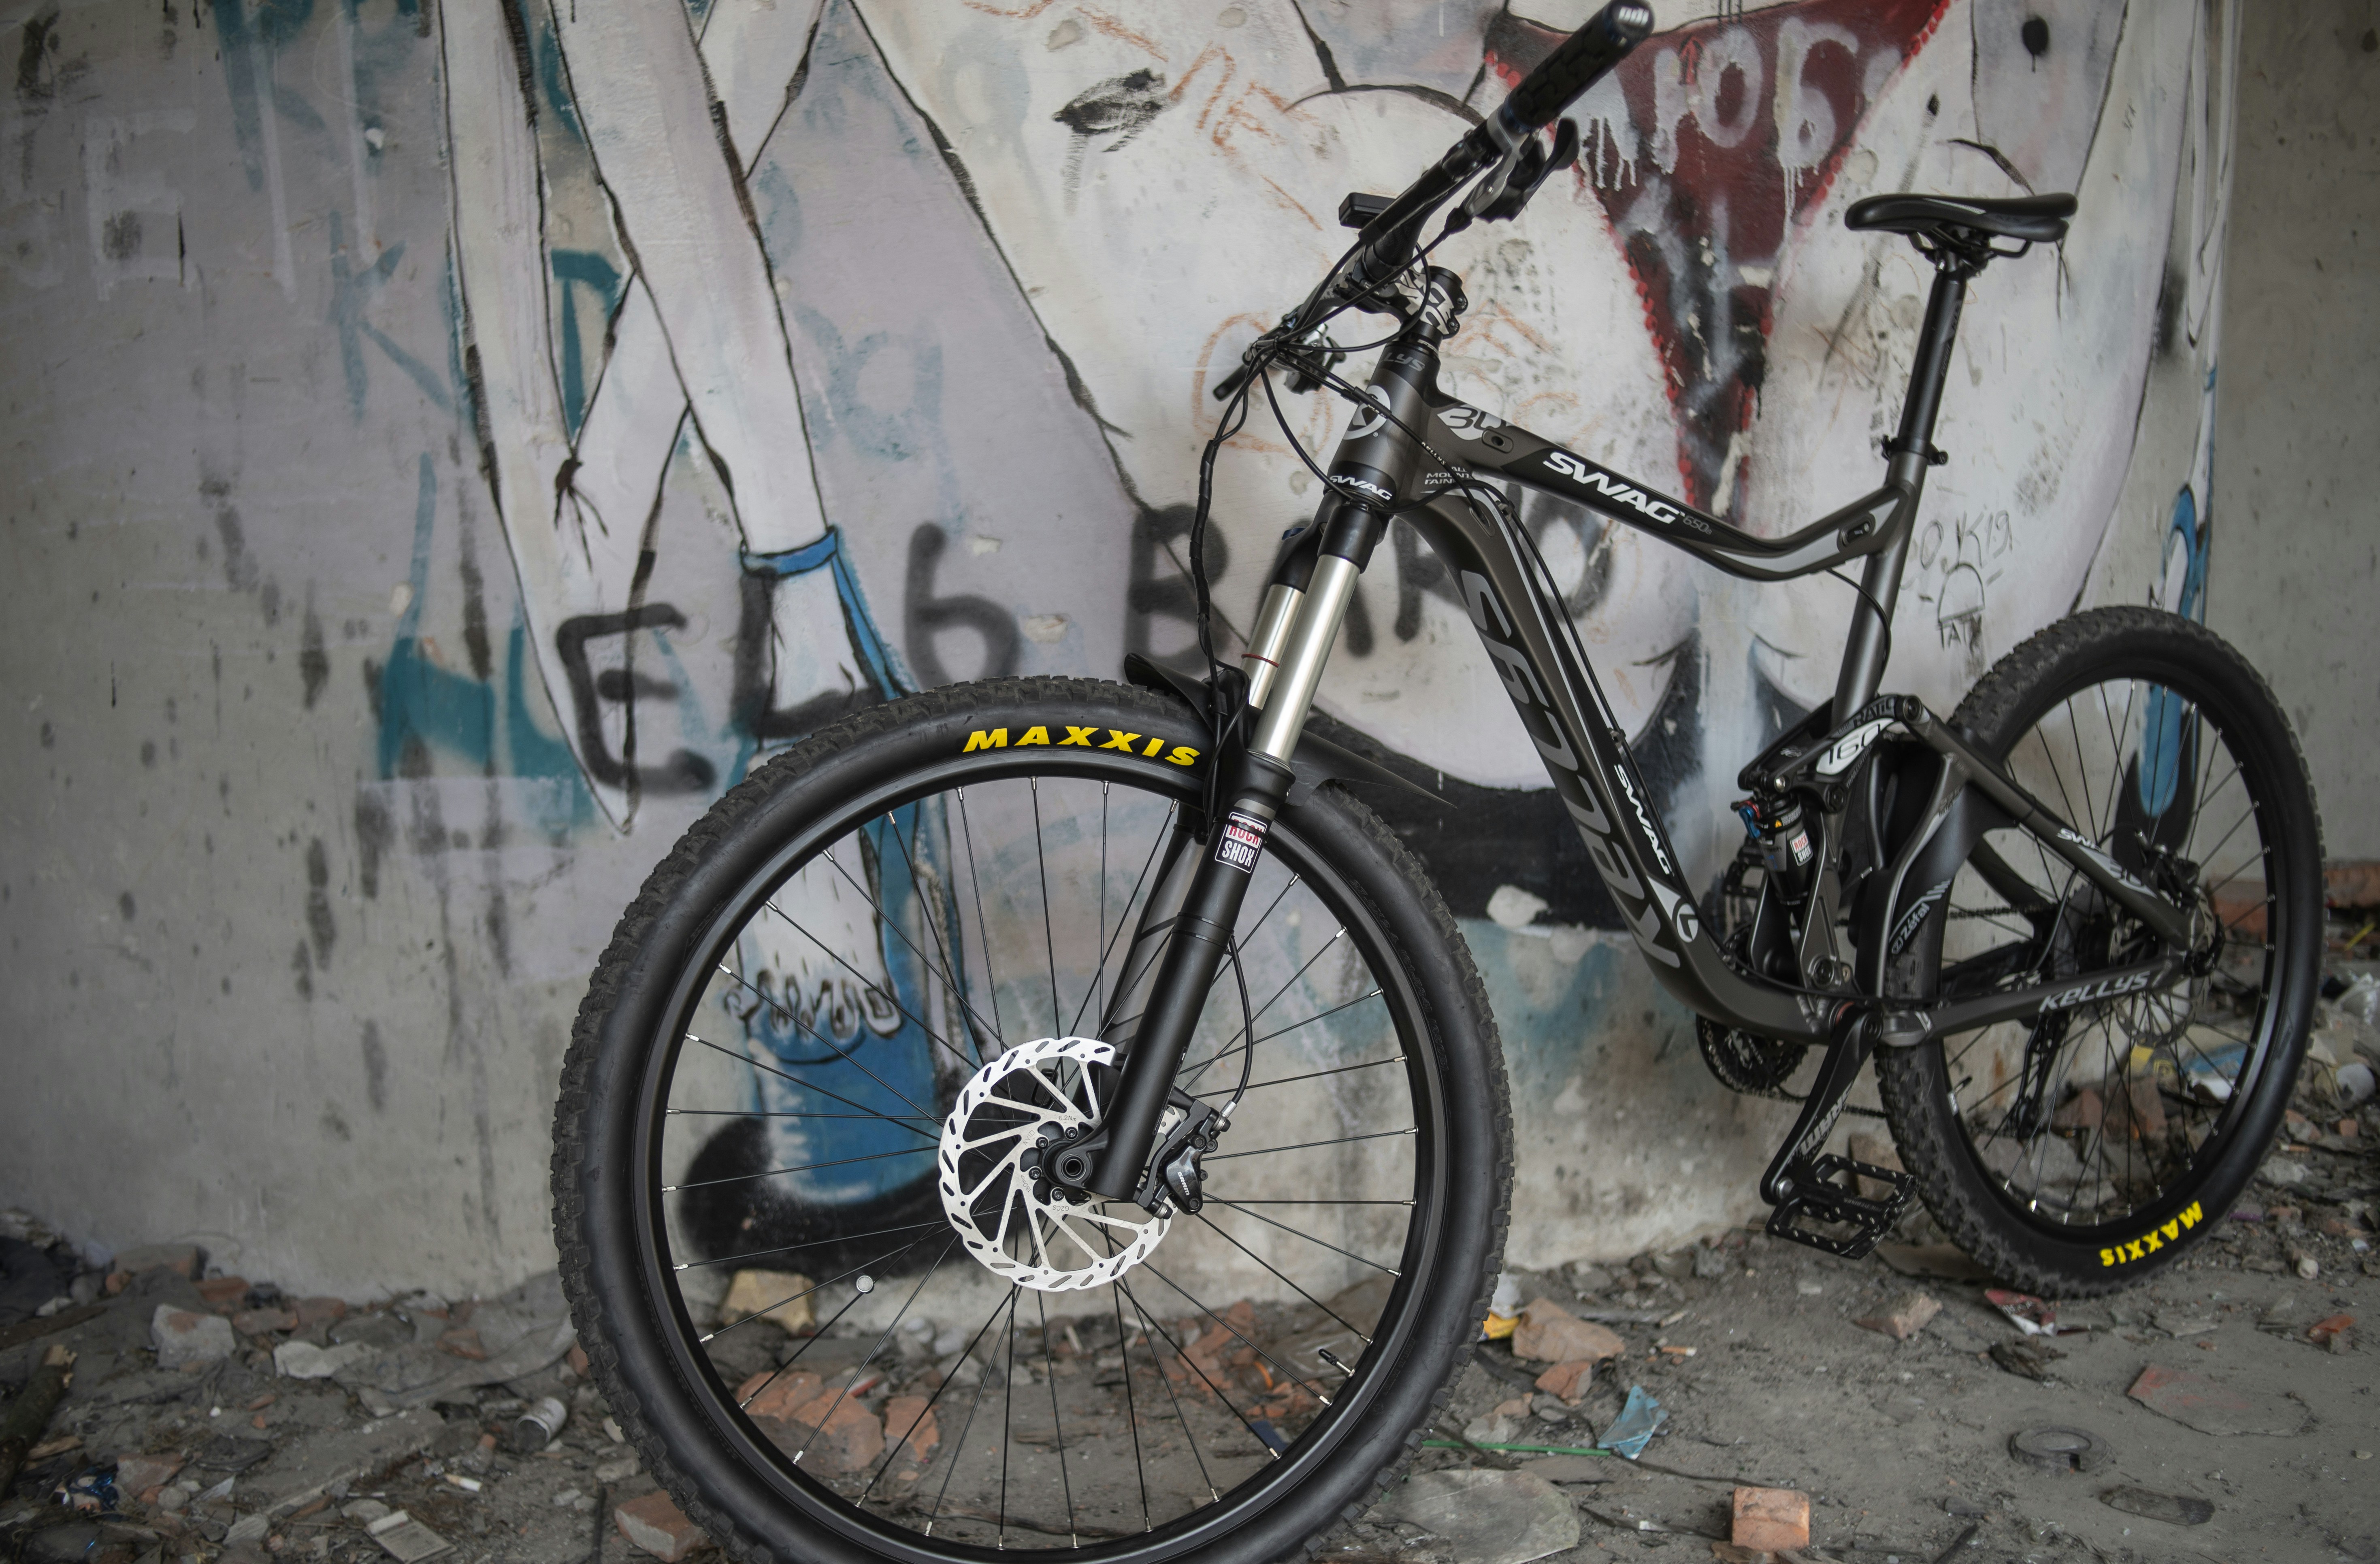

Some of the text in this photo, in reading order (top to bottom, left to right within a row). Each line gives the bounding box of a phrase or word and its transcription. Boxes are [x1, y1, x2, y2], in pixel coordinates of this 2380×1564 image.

[1330, 475, 1393, 501] SWAG
[1543, 451, 1681, 525] SWAG
[963, 726, 1201, 766] MAXXIS
[1613, 763, 1670, 875] SWAG
[1222, 841, 1255, 866] SHOX
[1794, 834, 1808, 851] ROCK
[2039, 971, 2151, 1013] KELLYS
[1023, 1130, 1035, 1146] AVID
[1021, 1174, 1031, 1193] 180mm
[1177, 1171, 1190, 1196] SRAM
[2099, 1200, 2203, 1267] MAXXIS
